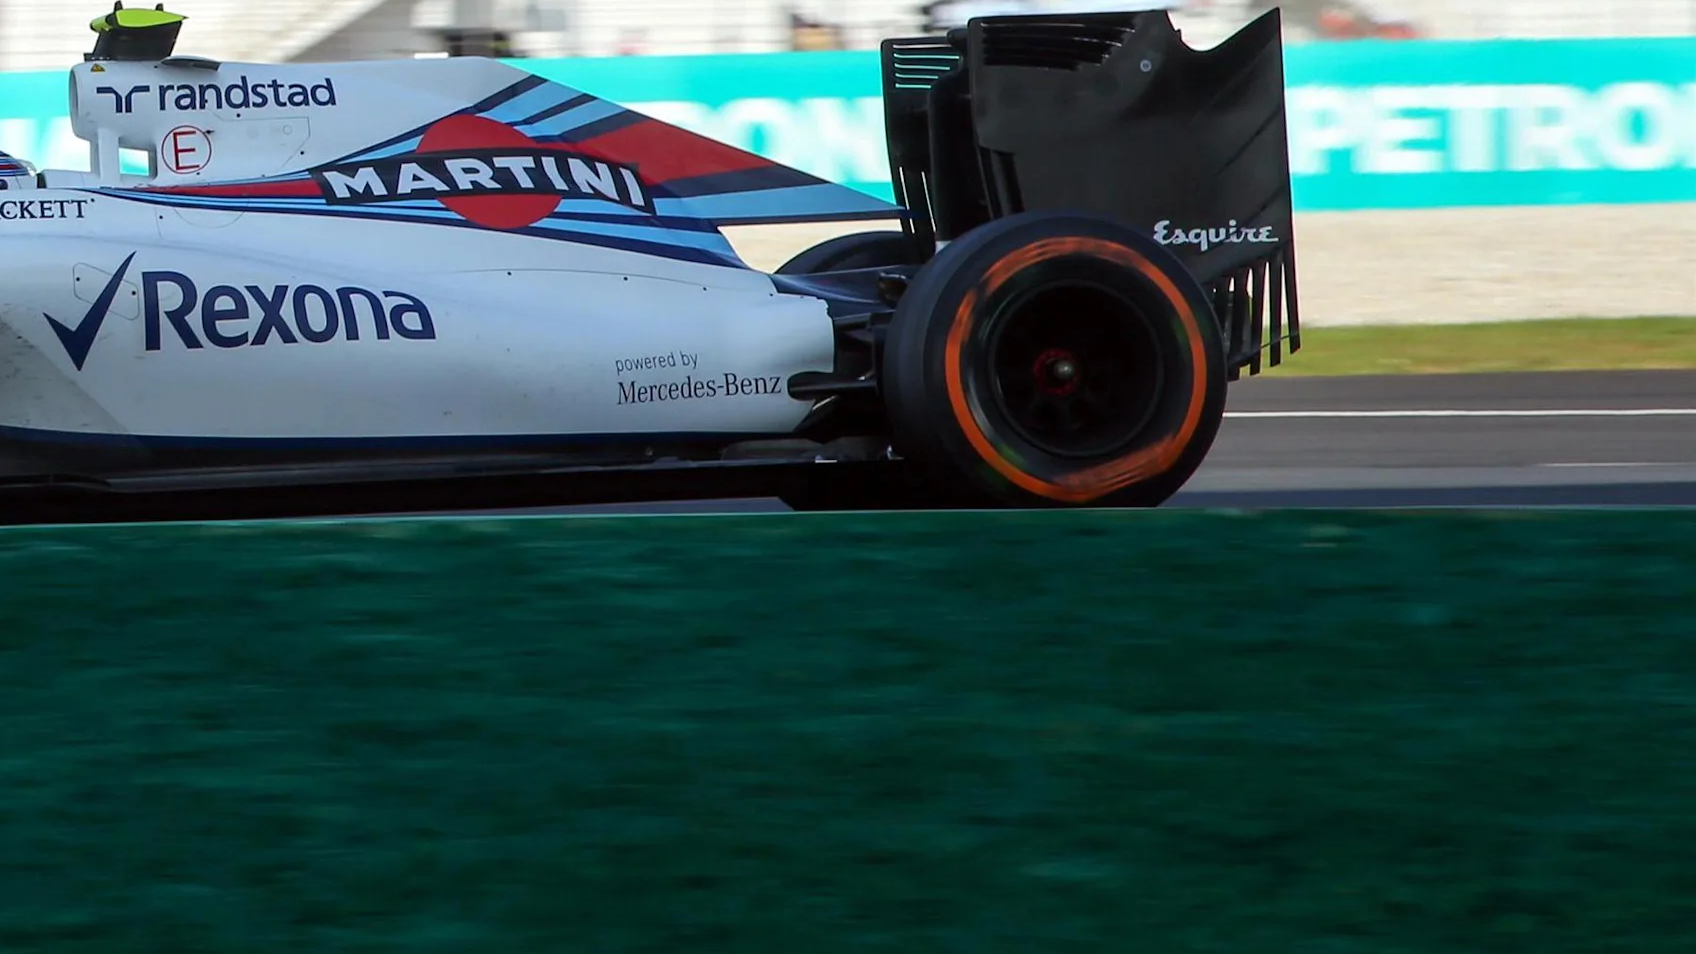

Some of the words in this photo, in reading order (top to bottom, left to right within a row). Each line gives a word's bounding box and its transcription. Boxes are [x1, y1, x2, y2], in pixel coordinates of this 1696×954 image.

[158, 75, 336, 111] randstad
[1284, 81, 1696, 173] PETRO
[322, 156, 645, 207] MARTINI
[1153, 219, 1279, 252] Esquire
[141, 270, 436, 351] Rexona
[615, 352, 677, 375] powered
[680, 350, 699, 369] by
[617, 372, 782, 405] Mercedes-Benz
